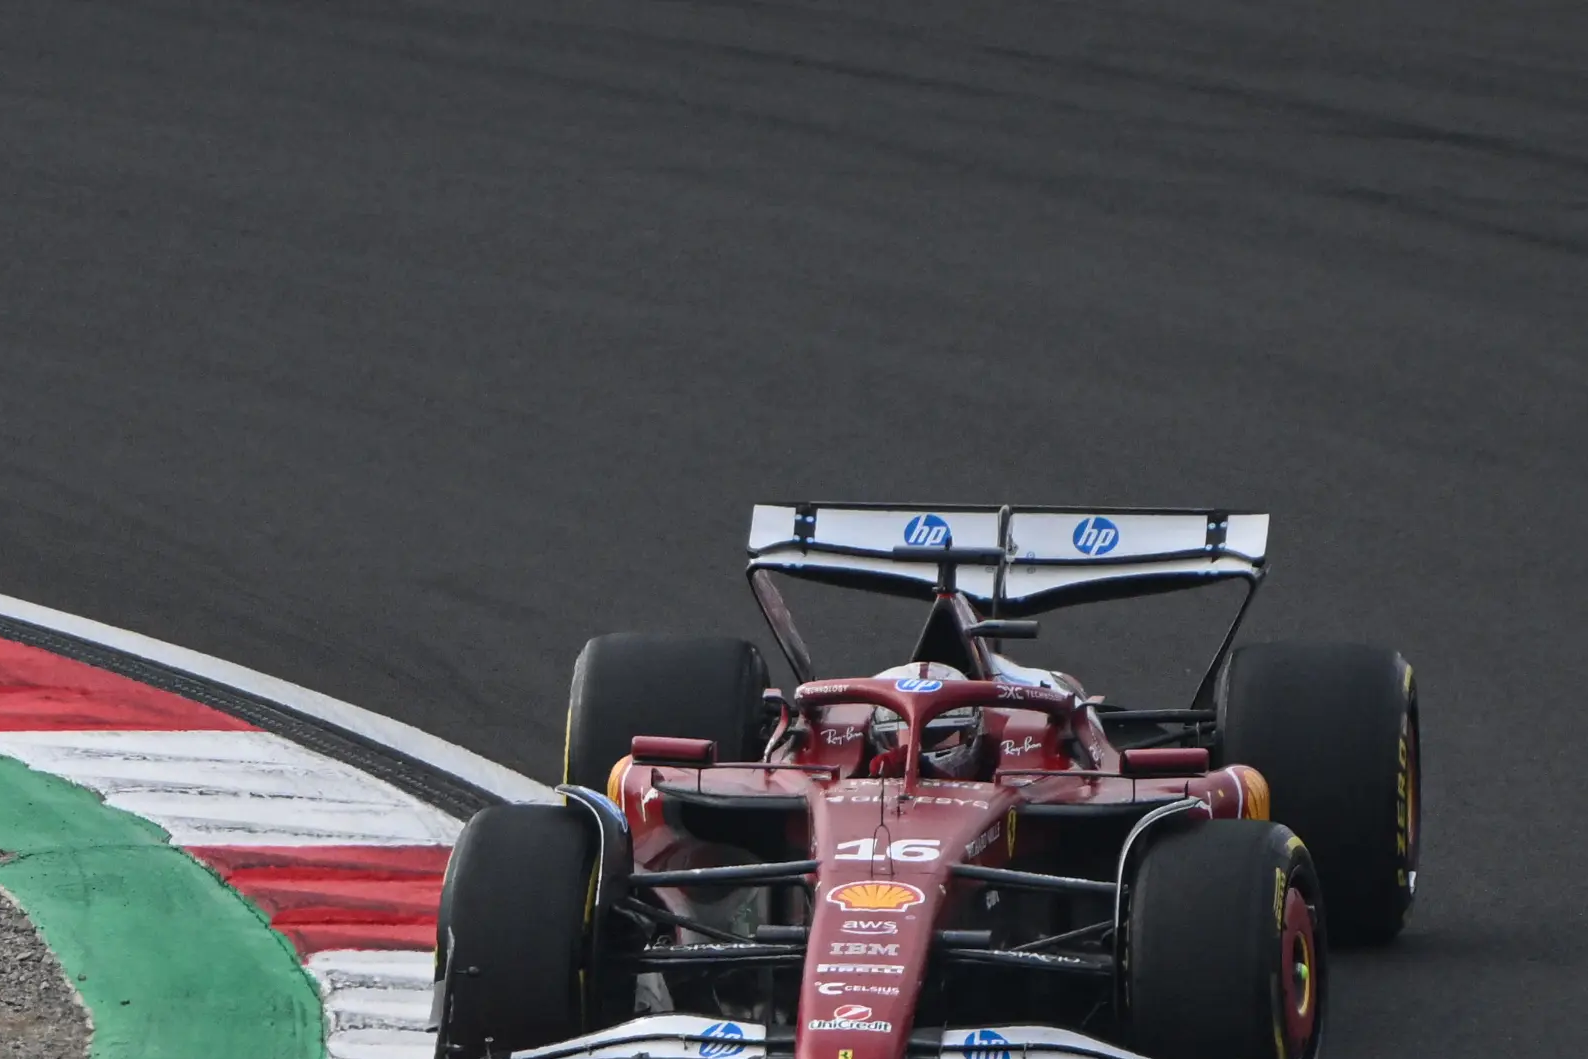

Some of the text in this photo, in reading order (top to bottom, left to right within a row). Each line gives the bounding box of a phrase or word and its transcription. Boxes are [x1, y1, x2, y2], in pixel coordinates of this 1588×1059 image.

[907, 514, 949, 547] hp
[1076, 517, 1118, 555] hp
[1000, 736, 1042, 756] Ray-Ban
[835, 838, 941, 862] 16
[842, 920, 898, 930] aws
[829, 943, 900, 956] IBM
[817, 963, 905, 974] PIRELLI
[845, 985, 900, 994] CELSIUS
[808, 1019, 892, 1033] UniCredit
[700, 1022, 743, 1059] hp
